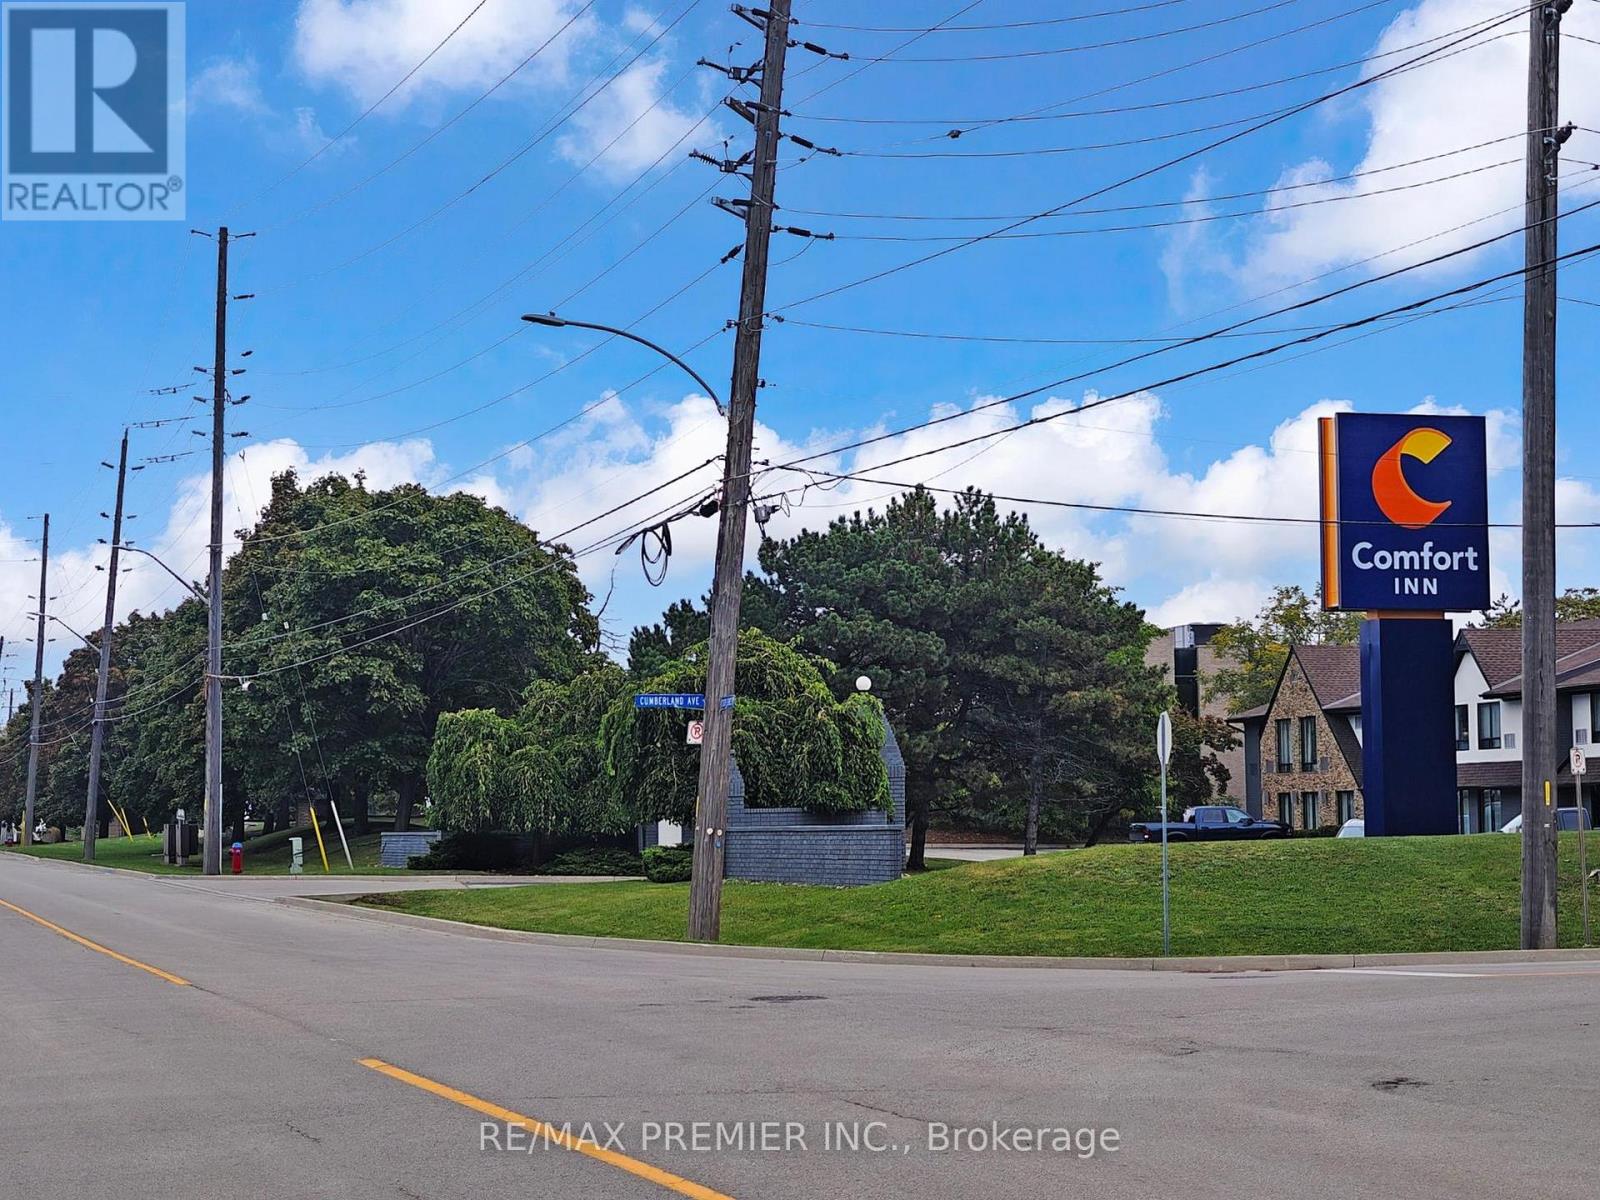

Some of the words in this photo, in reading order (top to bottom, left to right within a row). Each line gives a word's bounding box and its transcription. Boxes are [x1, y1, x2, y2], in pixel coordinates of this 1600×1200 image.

[1351, 541, 1479, 571] Comfort
[1394, 577, 1438, 595] INN
[640, 696, 683, 706] CUMBERLAND
[687, 697, 700, 706] AVE
